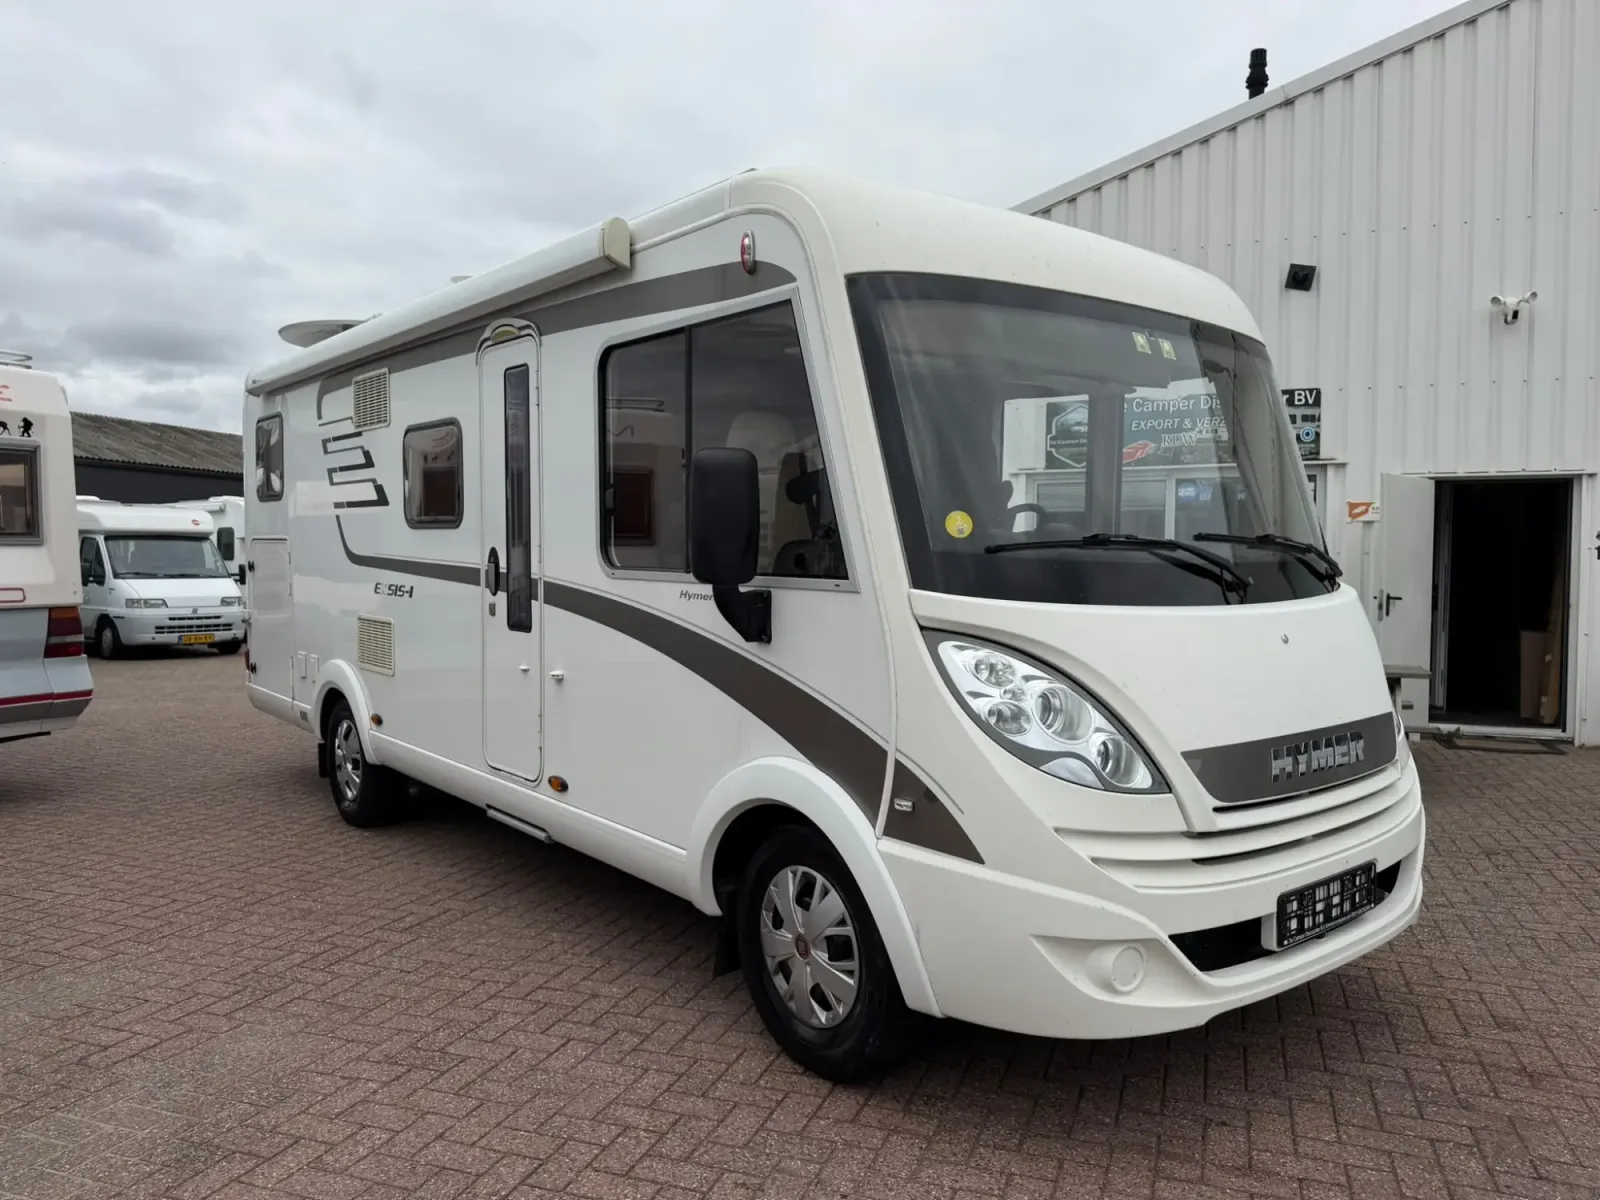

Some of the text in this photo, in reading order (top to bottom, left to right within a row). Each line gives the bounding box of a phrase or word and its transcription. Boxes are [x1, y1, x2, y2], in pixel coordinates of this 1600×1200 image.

[1133, 398, 1195, 413] Camper
[1294, 389, 1317, 405] BV
[1131, 418, 1180, 431] EXPORT
[1182, 417, 1192, 429] &
[1270, 731, 1365, 784] HYMER
